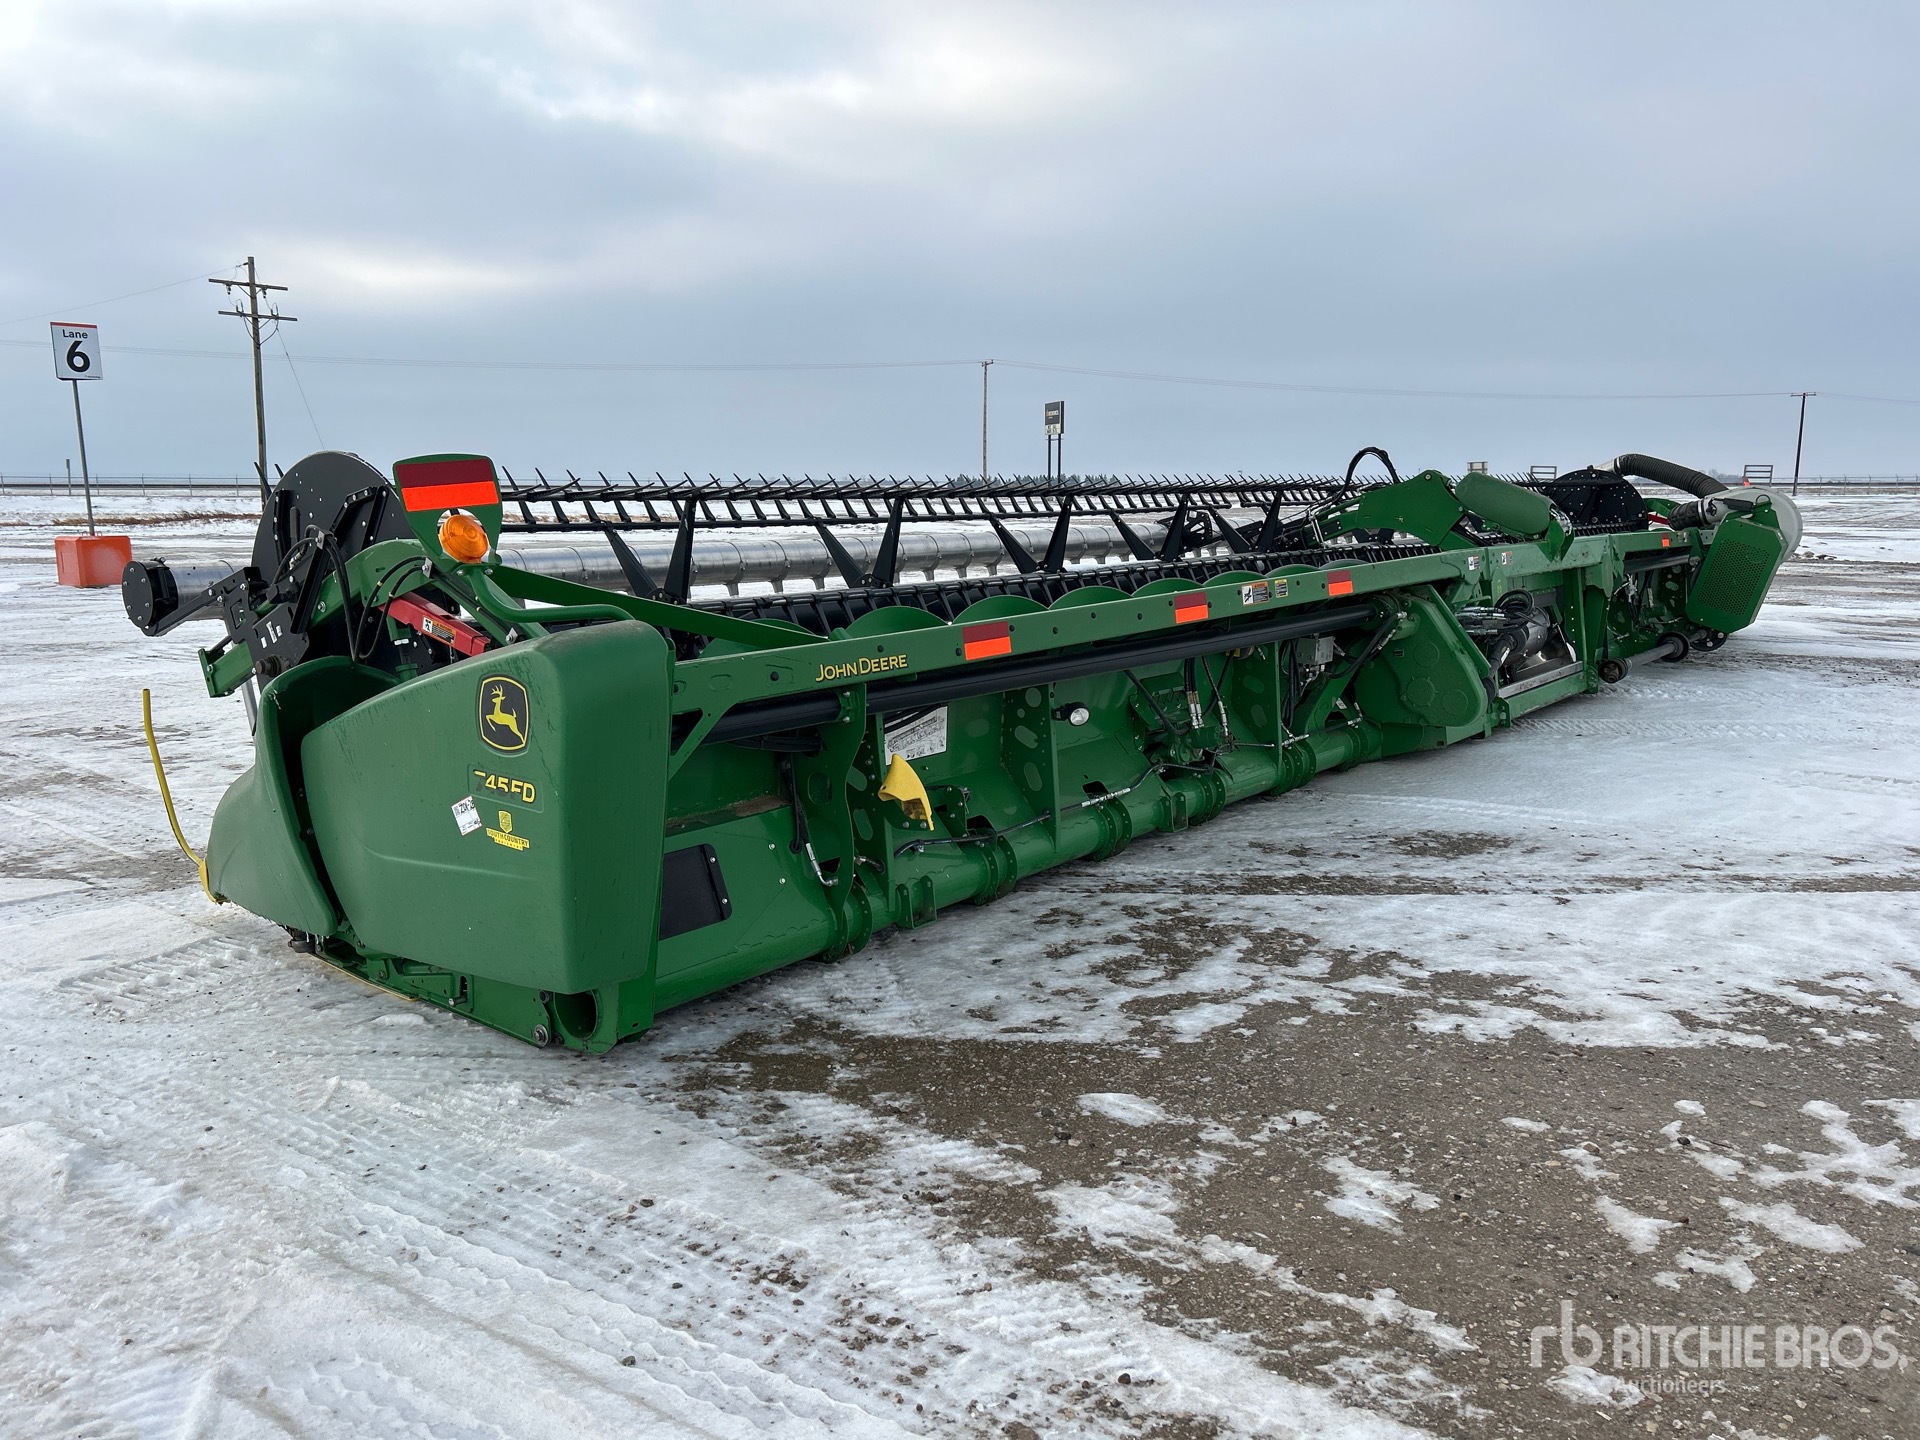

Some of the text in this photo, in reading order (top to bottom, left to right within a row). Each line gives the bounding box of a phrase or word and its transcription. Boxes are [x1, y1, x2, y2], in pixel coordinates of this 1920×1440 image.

[62, 328, 88, 339] Lane
[66, 340, 91, 373] 6
[815, 654, 908, 682] JOHN DEERE
